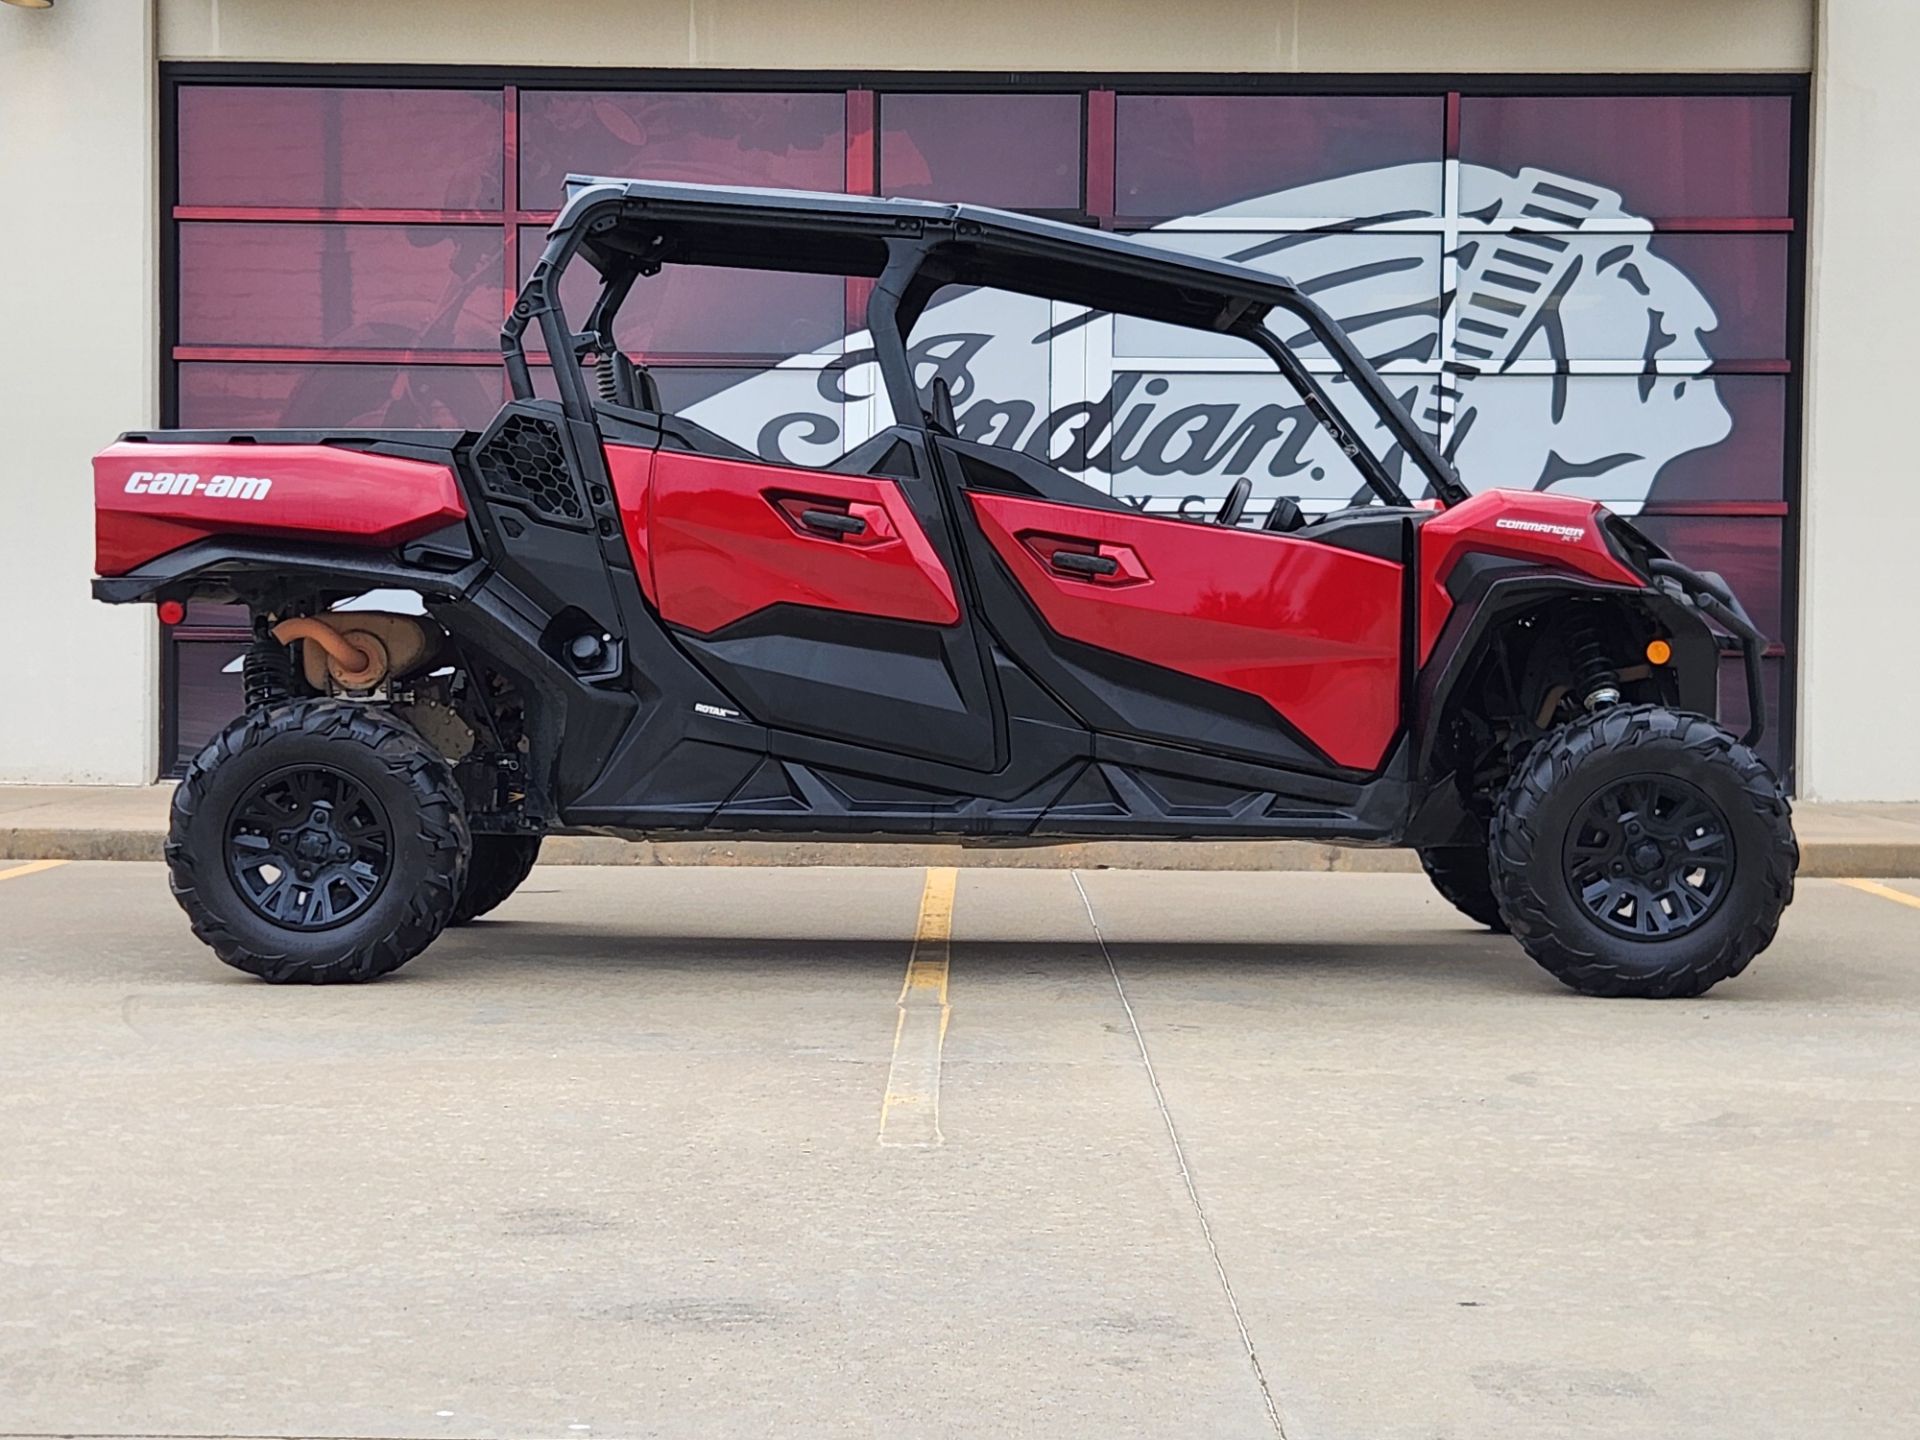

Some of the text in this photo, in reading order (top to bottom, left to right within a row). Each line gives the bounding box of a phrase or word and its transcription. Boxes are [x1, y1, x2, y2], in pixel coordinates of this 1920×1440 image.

[124, 471, 272, 500] can-am
[1496, 518, 1585, 536] COMMANDER
[695, 703, 727, 717] ROTAX
